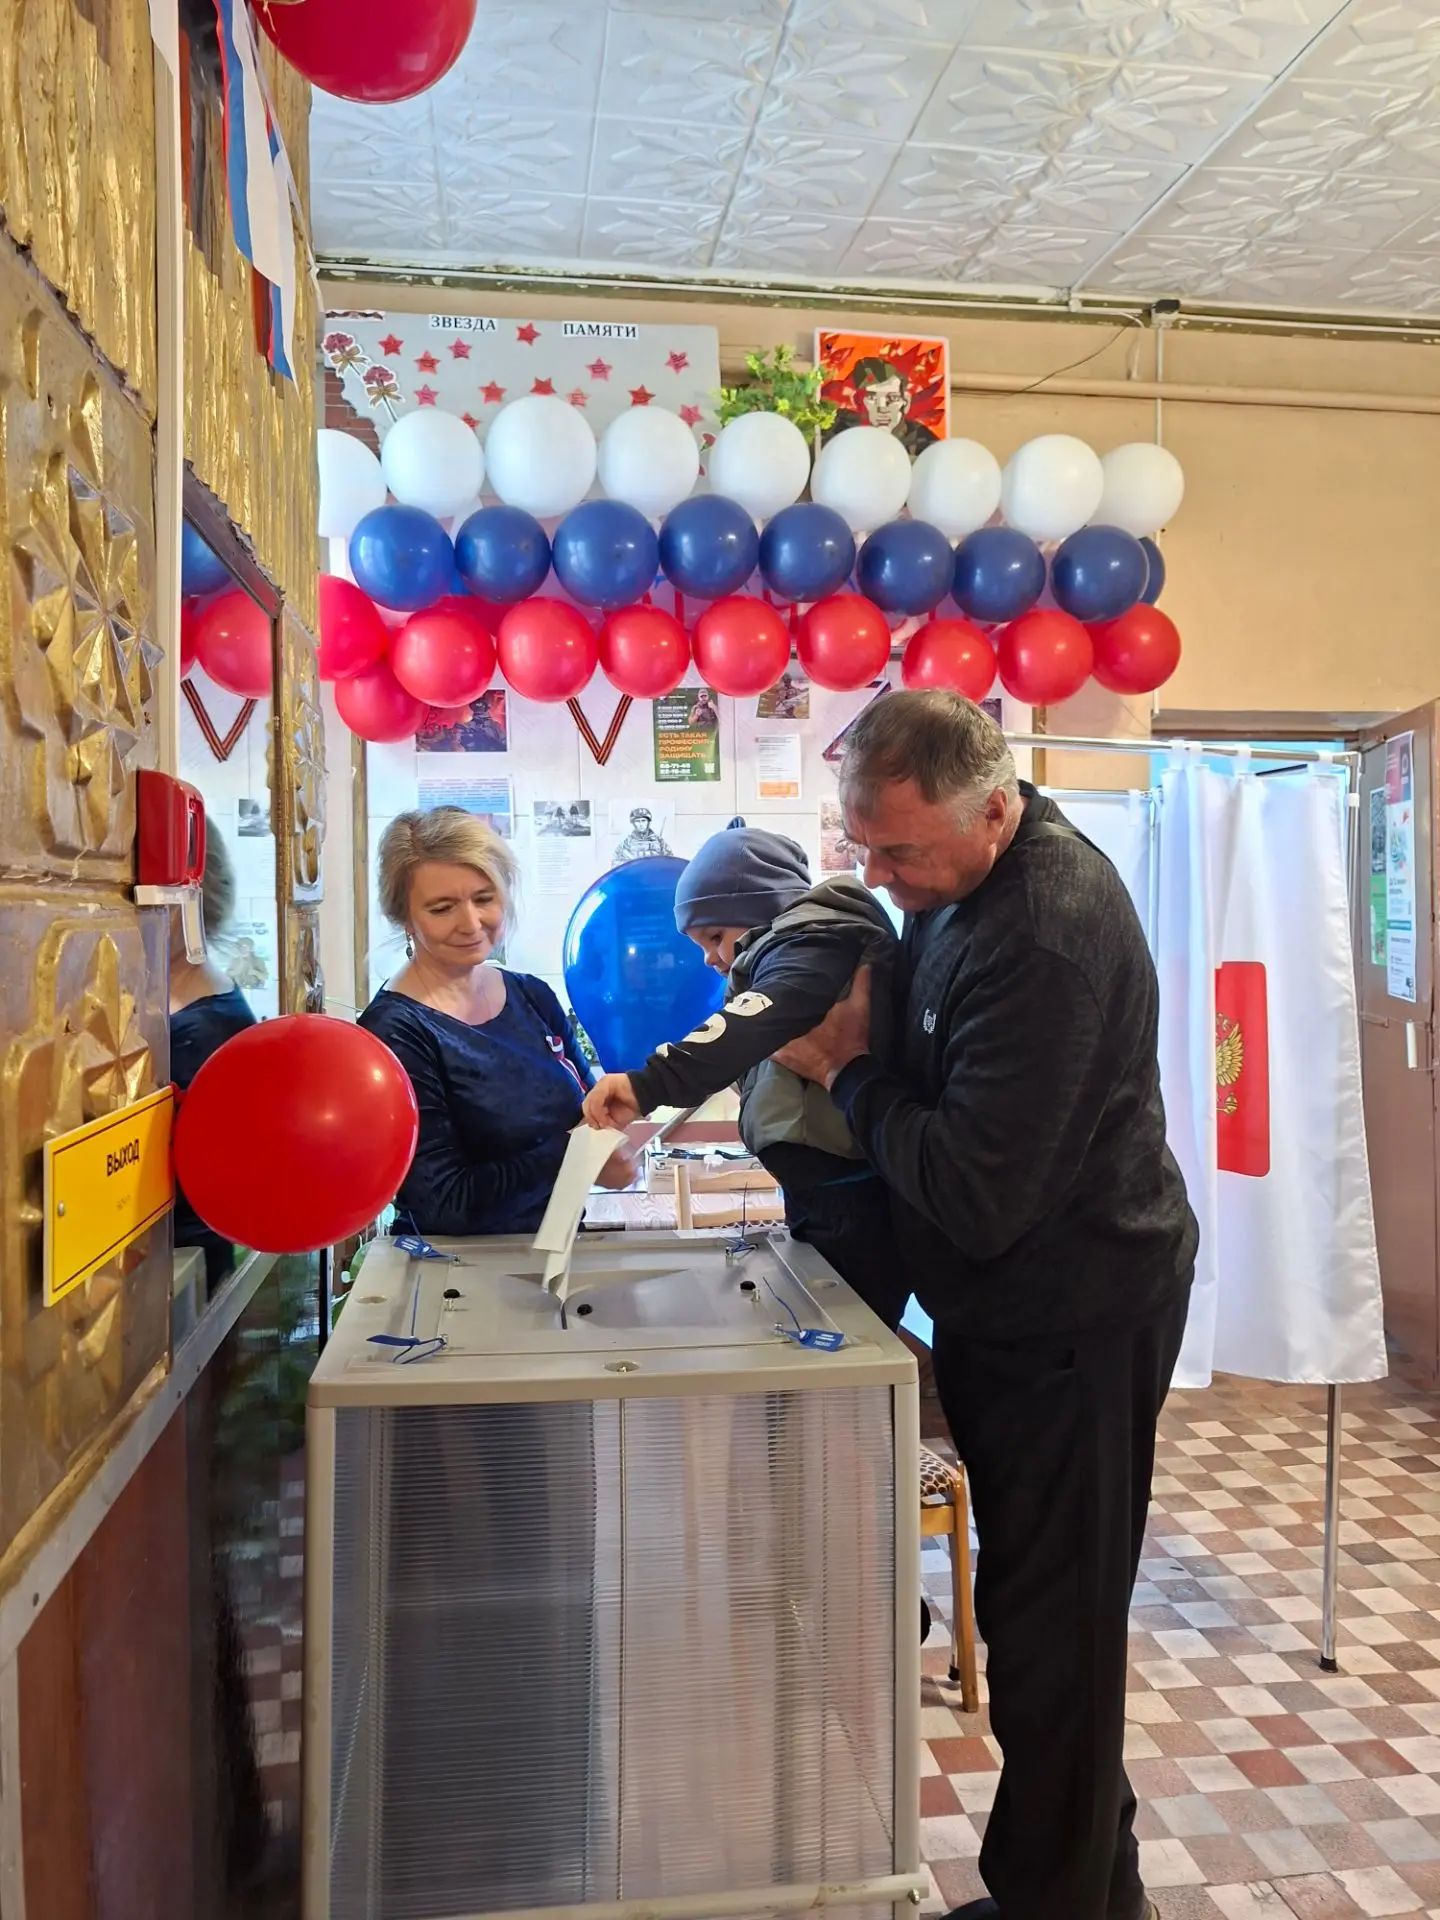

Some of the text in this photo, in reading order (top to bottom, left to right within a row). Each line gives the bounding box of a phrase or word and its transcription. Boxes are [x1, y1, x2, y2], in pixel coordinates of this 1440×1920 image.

[431, 315, 636, 338] ЗВЕЗДА ПАМЯТИ
[107, 1139, 139, 1176] ВЫХОД
